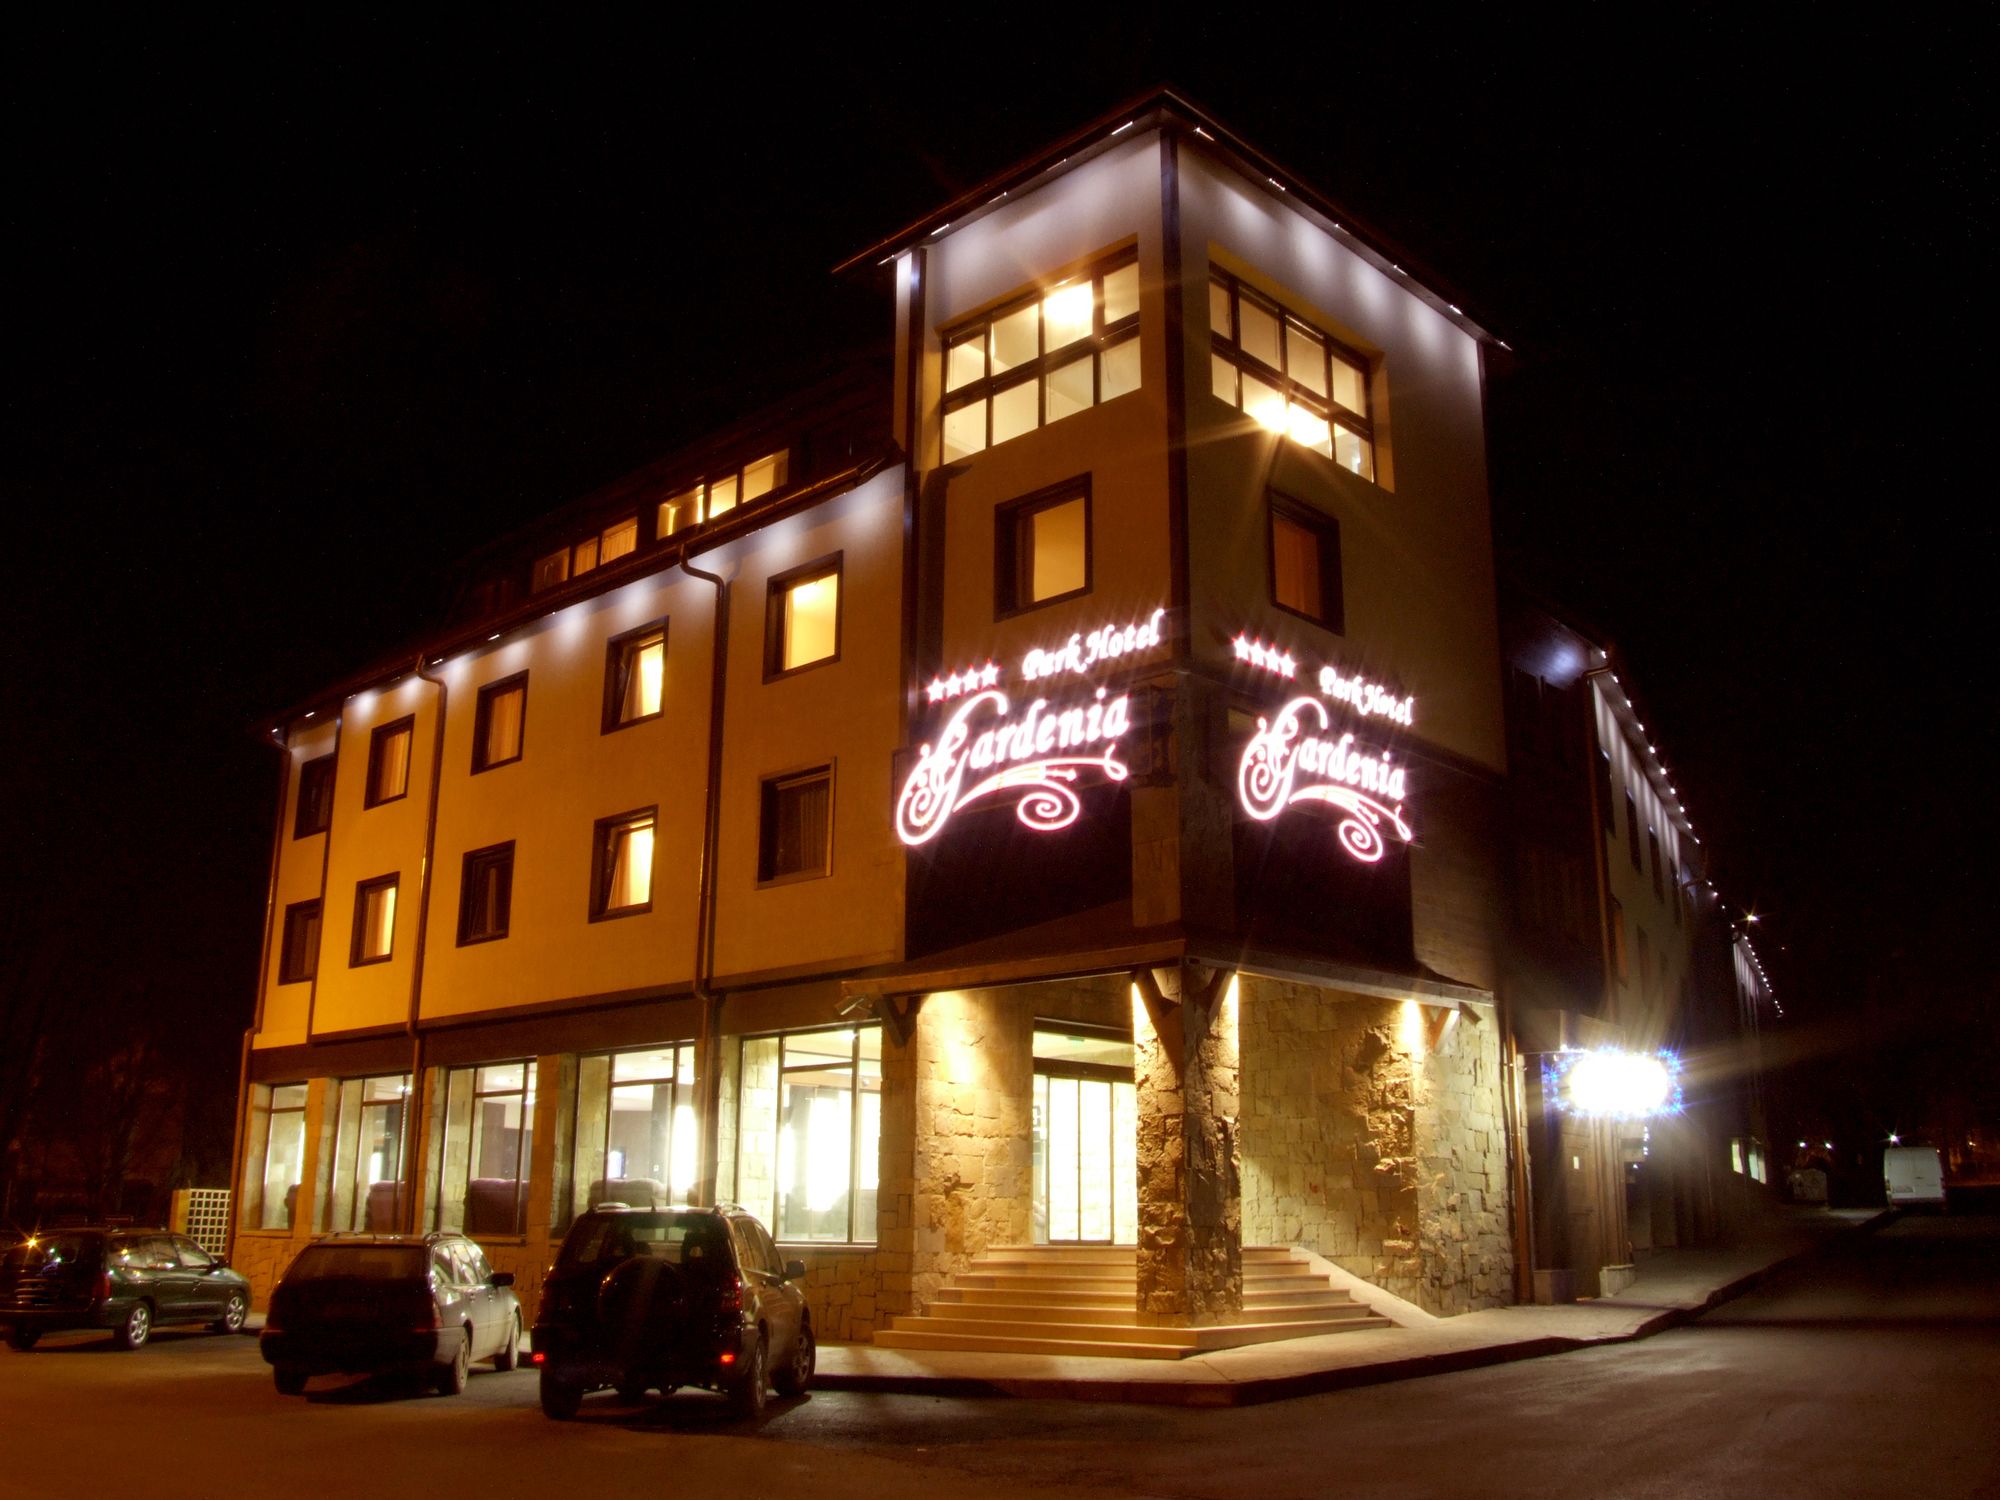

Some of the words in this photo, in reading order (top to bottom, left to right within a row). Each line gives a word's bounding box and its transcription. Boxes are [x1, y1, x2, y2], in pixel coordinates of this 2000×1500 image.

[1022, 632, 1086, 680] Park
[1084, 607, 1165, 664] Hotel
[1319, 665, 1371, 716] Park
[1364, 684, 1414, 726] Hotel
[896, 689, 1130, 846] Gardenia
[1239, 696, 1406, 821] Gardenia
